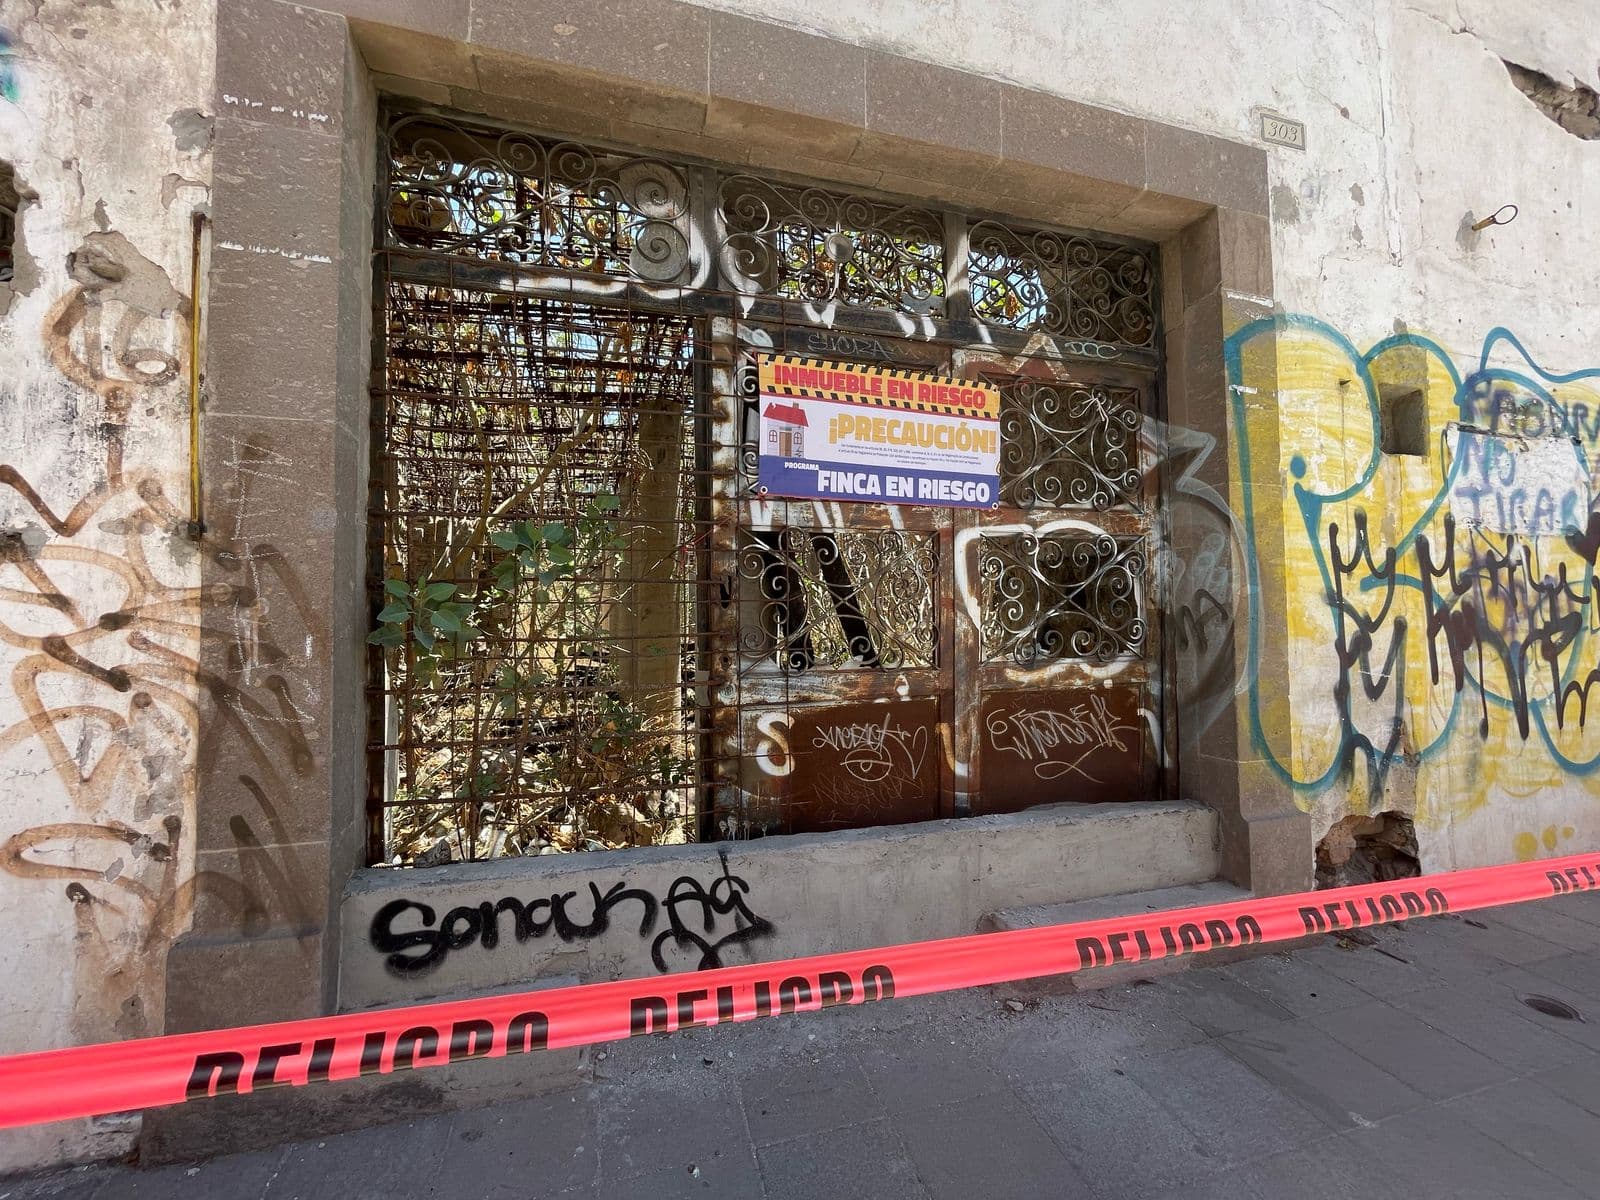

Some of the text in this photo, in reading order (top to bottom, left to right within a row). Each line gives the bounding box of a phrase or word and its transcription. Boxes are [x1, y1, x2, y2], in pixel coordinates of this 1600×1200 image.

[1268, 121, 1298, 142] 303
[774, 364, 986, 410] INMUEBLE EN RIESGO
[829, 412, 997, 455] ¡PRECAUCIÓN!
[784, 461, 820, 472] PROGRAMA
[817, 469, 991, 503] FINCA EN RIESGO
